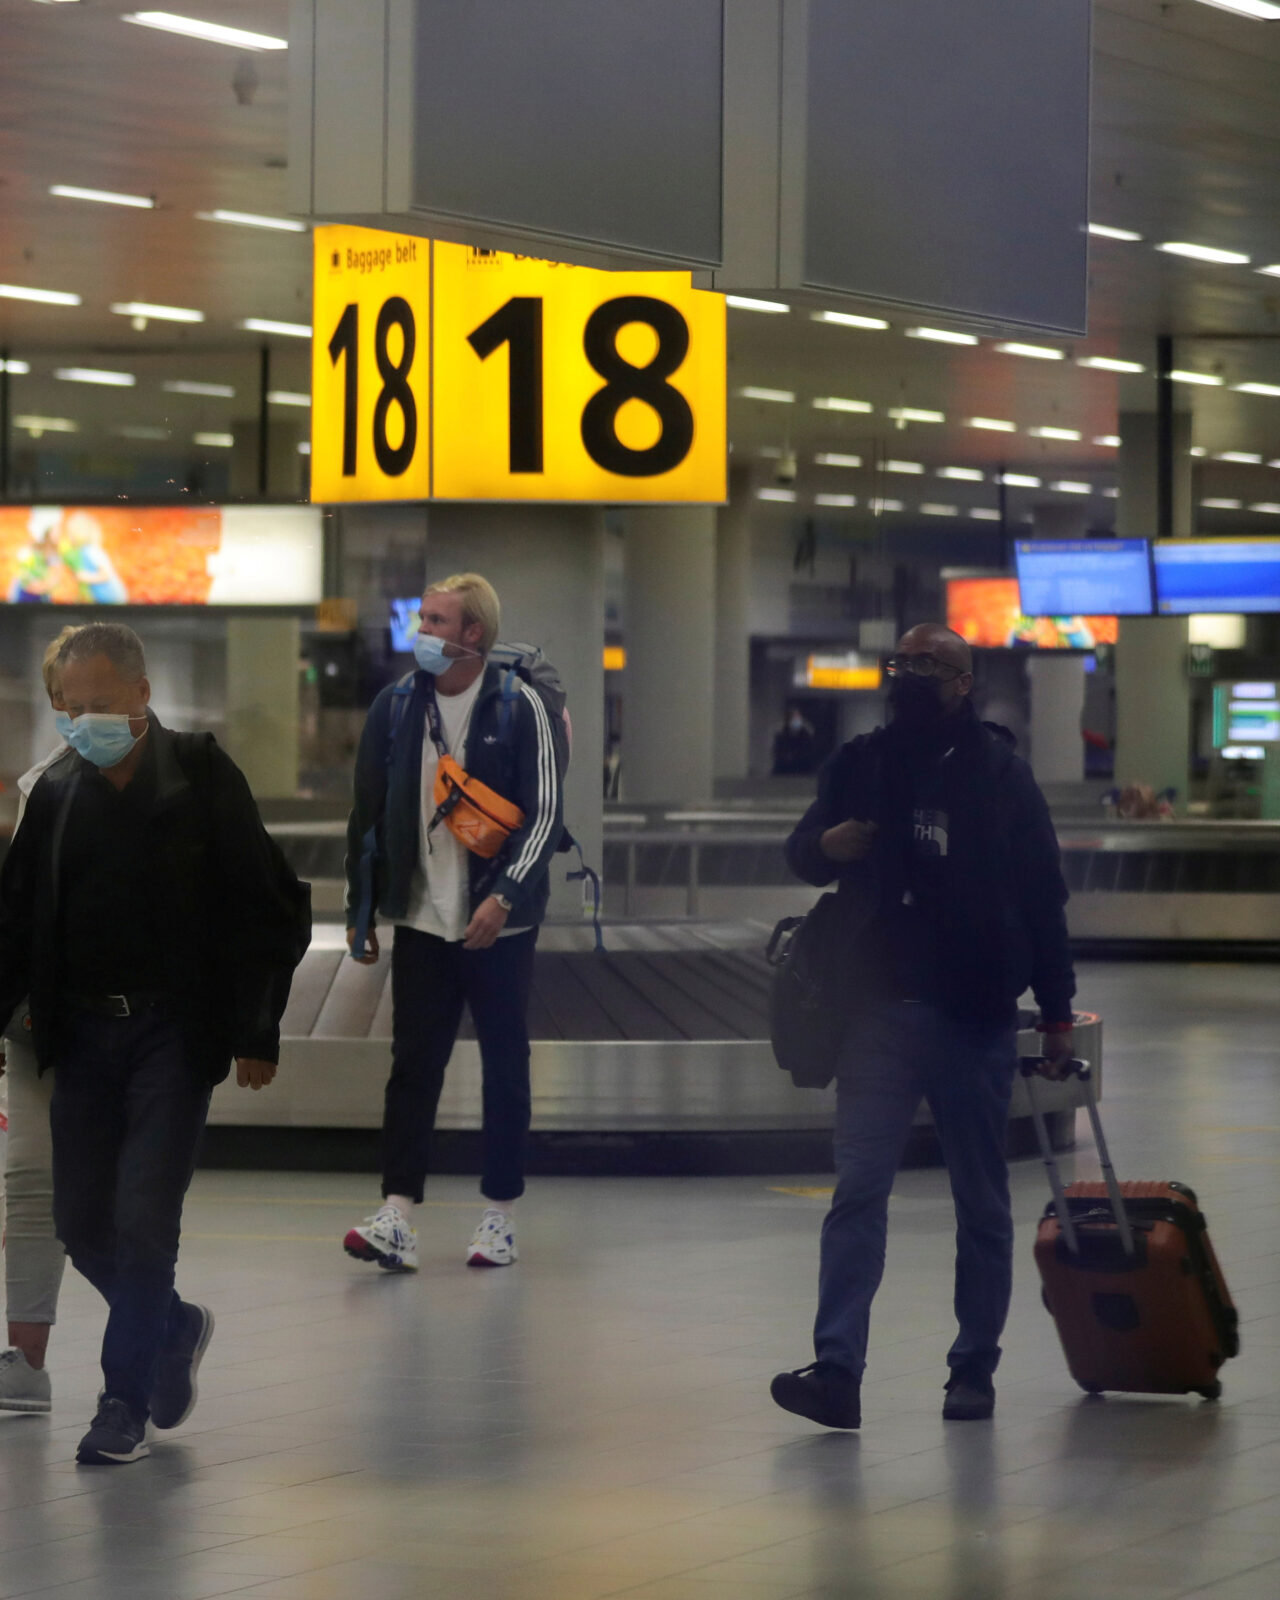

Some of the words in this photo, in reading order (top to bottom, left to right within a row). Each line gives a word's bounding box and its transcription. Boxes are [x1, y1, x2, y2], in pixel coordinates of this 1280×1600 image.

[346, 247, 392, 273] Baggage
[396, 240, 417, 263] belt
[328, 297, 418, 478] 18
[466, 295, 695, 479] 18
